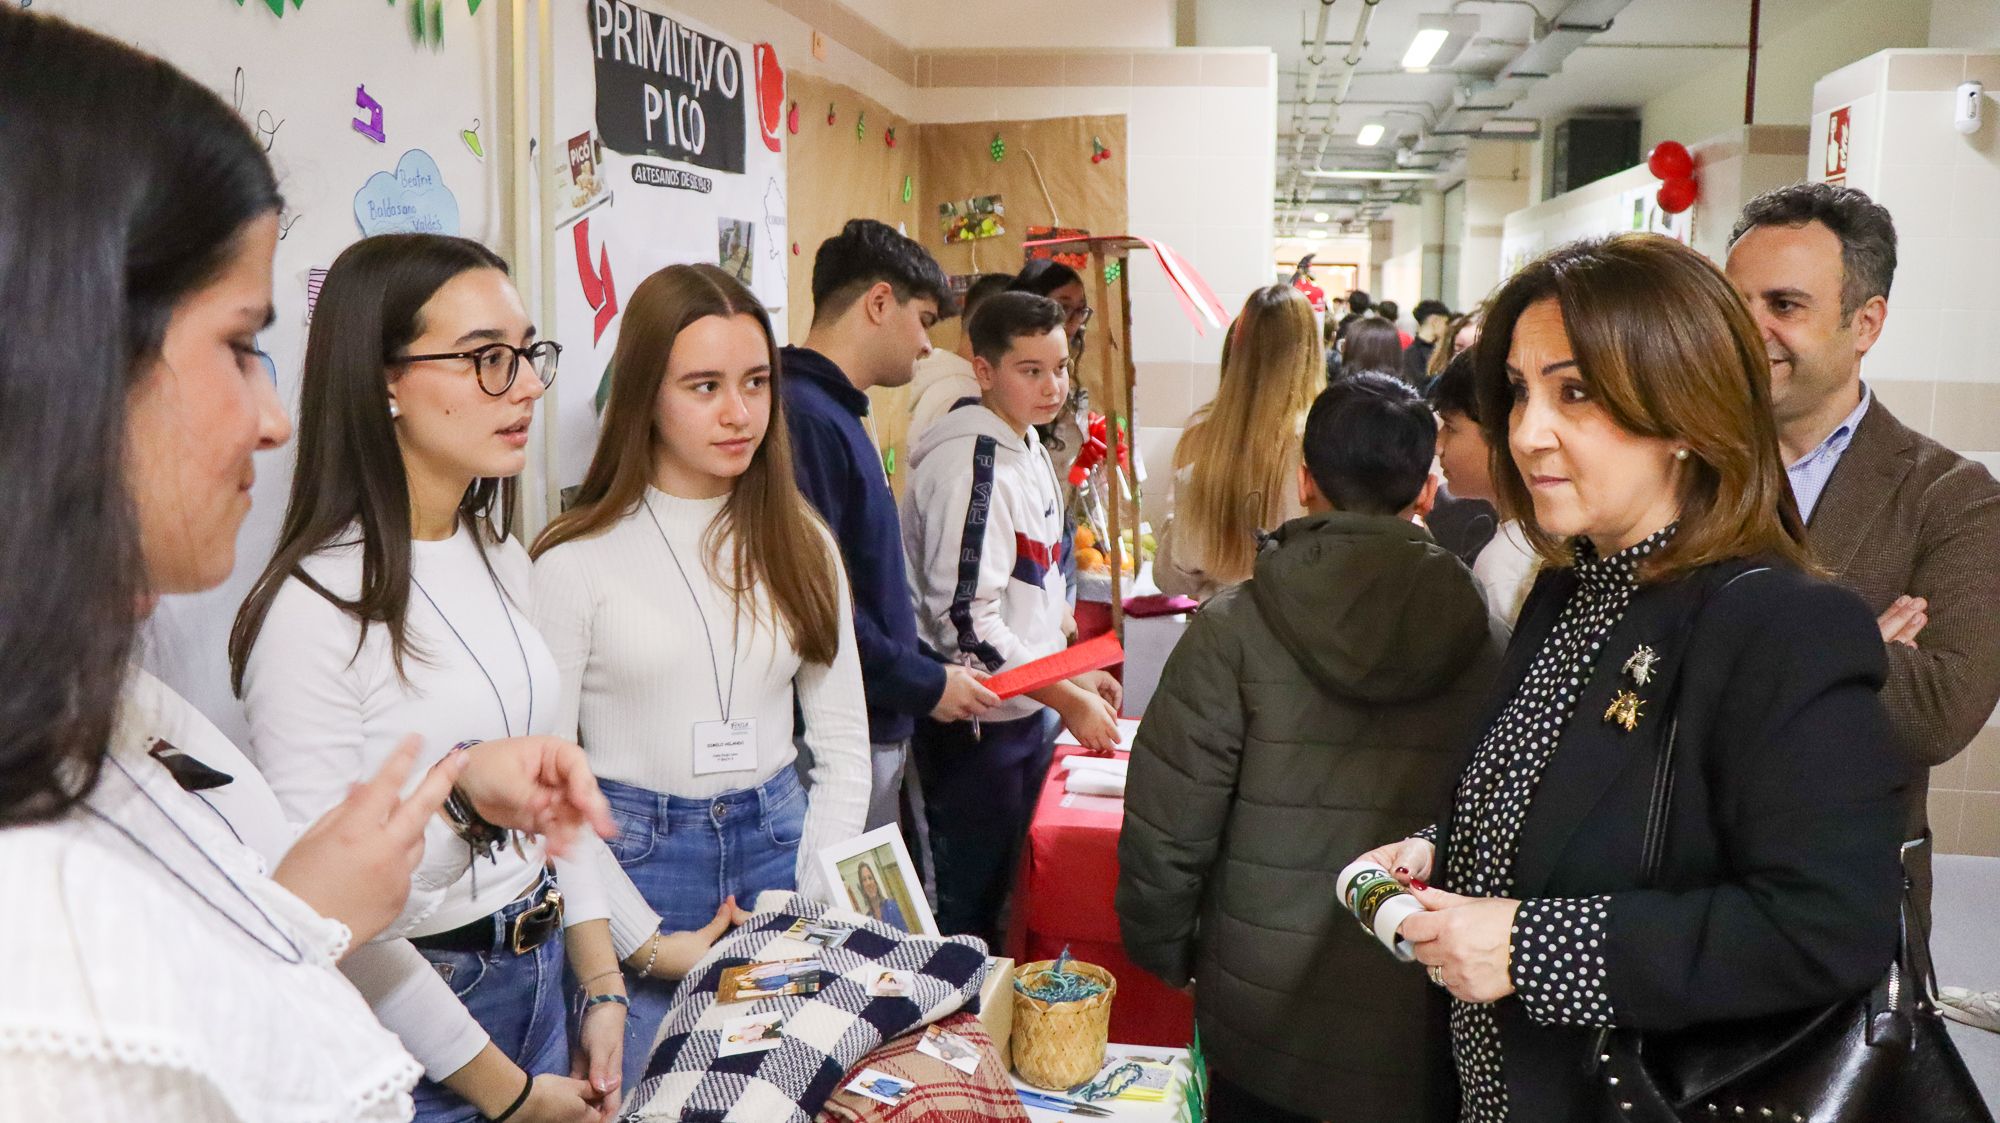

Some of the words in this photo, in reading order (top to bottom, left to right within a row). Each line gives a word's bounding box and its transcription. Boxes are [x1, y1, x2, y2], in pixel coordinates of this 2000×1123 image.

[595, 0, 739, 99] PRIMITIVO
[644, 79, 706, 155] PICÓ
[400, 168, 432, 188] Beatriz
[635, 166, 680, 186] ARTESANOS
[968, 482, 992, 524] FILA
